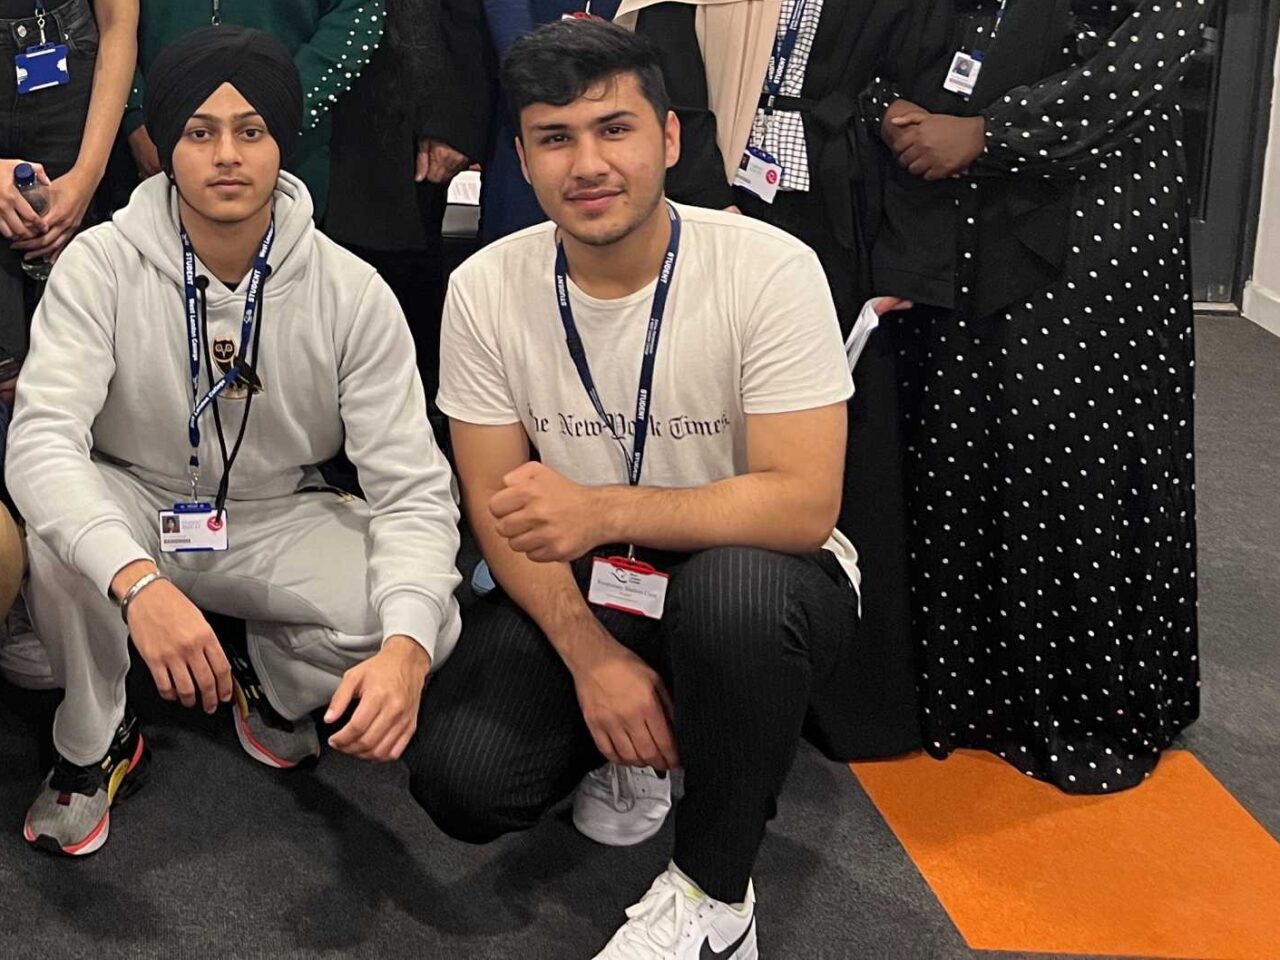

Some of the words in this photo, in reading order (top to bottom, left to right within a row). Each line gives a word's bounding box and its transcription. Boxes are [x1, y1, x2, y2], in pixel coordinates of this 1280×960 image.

[773, 56, 787, 85] STUDENT
[258, 240, 268, 258] West
[185, 252, 194, 286] STUDENT
[660, 251, 675, 284] STUDENT
[248, 269, 262, 303] STUDENT
[557, 275, 568, 307] STUDENT
[188, 297, 196, 314] West
[190, 313, 198, 340] London
[208, 378, 227, 400] College
[637, 388, 649, 421] STUDENT
